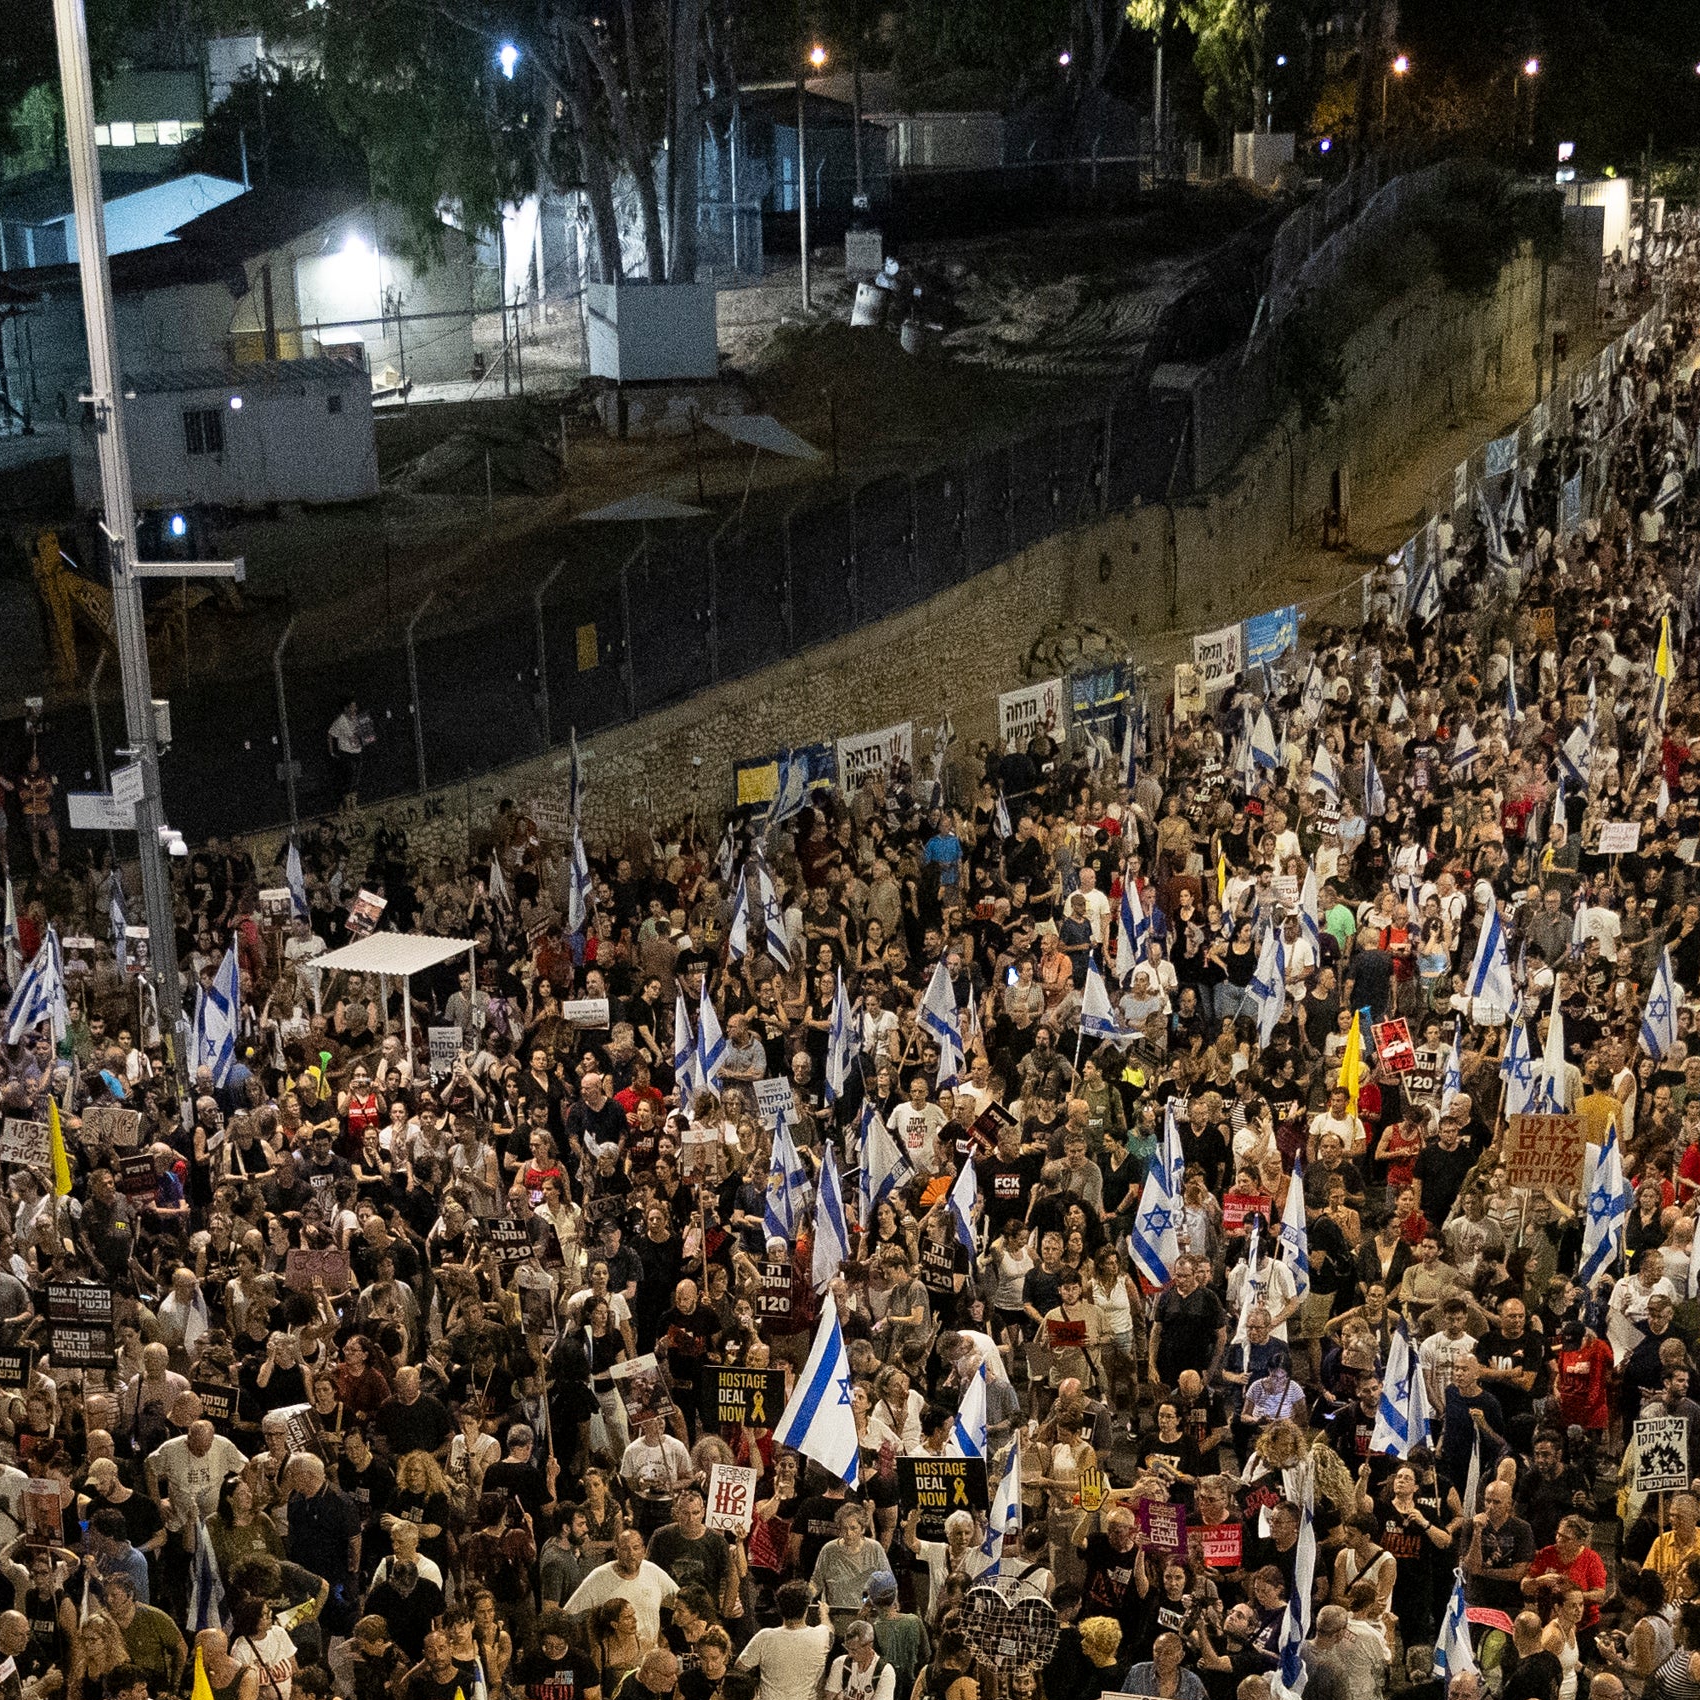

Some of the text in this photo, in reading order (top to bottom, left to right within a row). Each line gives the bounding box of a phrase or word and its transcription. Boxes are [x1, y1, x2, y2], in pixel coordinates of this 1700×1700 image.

[1004, 701, 1038, 720] הדחה
[844, 742, 883, 767] הדחה
[1405, 1075, 1433, 1088] 120
[1550, 1120, 1580, 1134] אין
[1519, 1135, 1581, 1151] ילדים
[1509, 1151, 1583, 1168] למלחמות
[995, 1176, 1021, 1189] FCK
[762, 1275, 791, 1289] עסקה
[920, 1269, 952, 1288] 120
[758, 1295, 790, 1312] 120
[719, 1372, 768, 1389] HOSTAGE
[718, 1389, 747, 1404] DEAL
[718, 1405, 746, 1424] NOW
[1663, 1430, 1684, 1442] לא
[718, 1465, 750, 1476] BRING
[914, 1462, 967, 1476] HOSTAGE
[915, 1476, 947, 1490] DEAL
[917, 1491, 947, 1506] NOW
